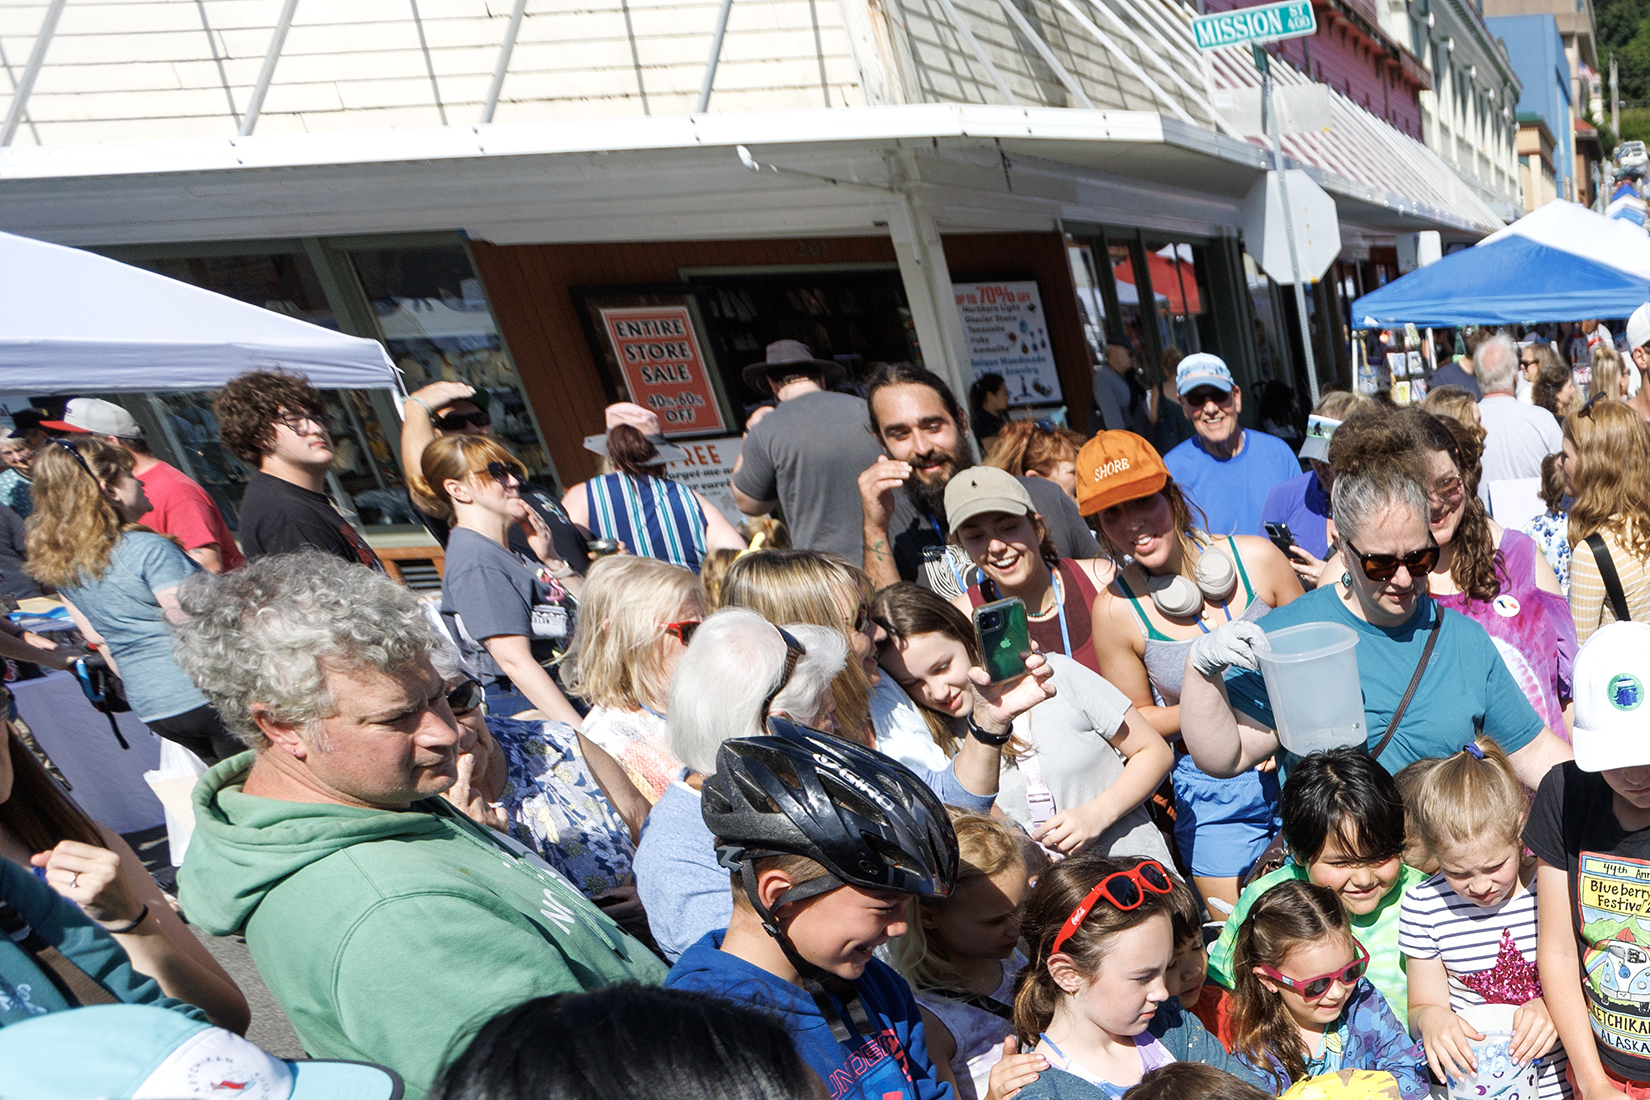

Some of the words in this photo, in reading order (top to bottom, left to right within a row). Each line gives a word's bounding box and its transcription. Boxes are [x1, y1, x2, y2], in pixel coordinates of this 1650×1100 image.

[1195, 8, 1283, 47] MISSION
[1289, 3, 1304, 18] ST
[1287, 14, 1312, 31] 400
[975, 285, 1016, 304] 70%
[614, 318, 688, 339] ENTIRE
[624, 341, 693, 364] STORE
[640, 363, 692, 385] SALE
[664, 408, 697, 424] OFF
[1094, 457, 1130, 482] SHORE
[1603, 862, 1627, 876] 44th
[1601, 1029, 1650, 1054] ALASKA
